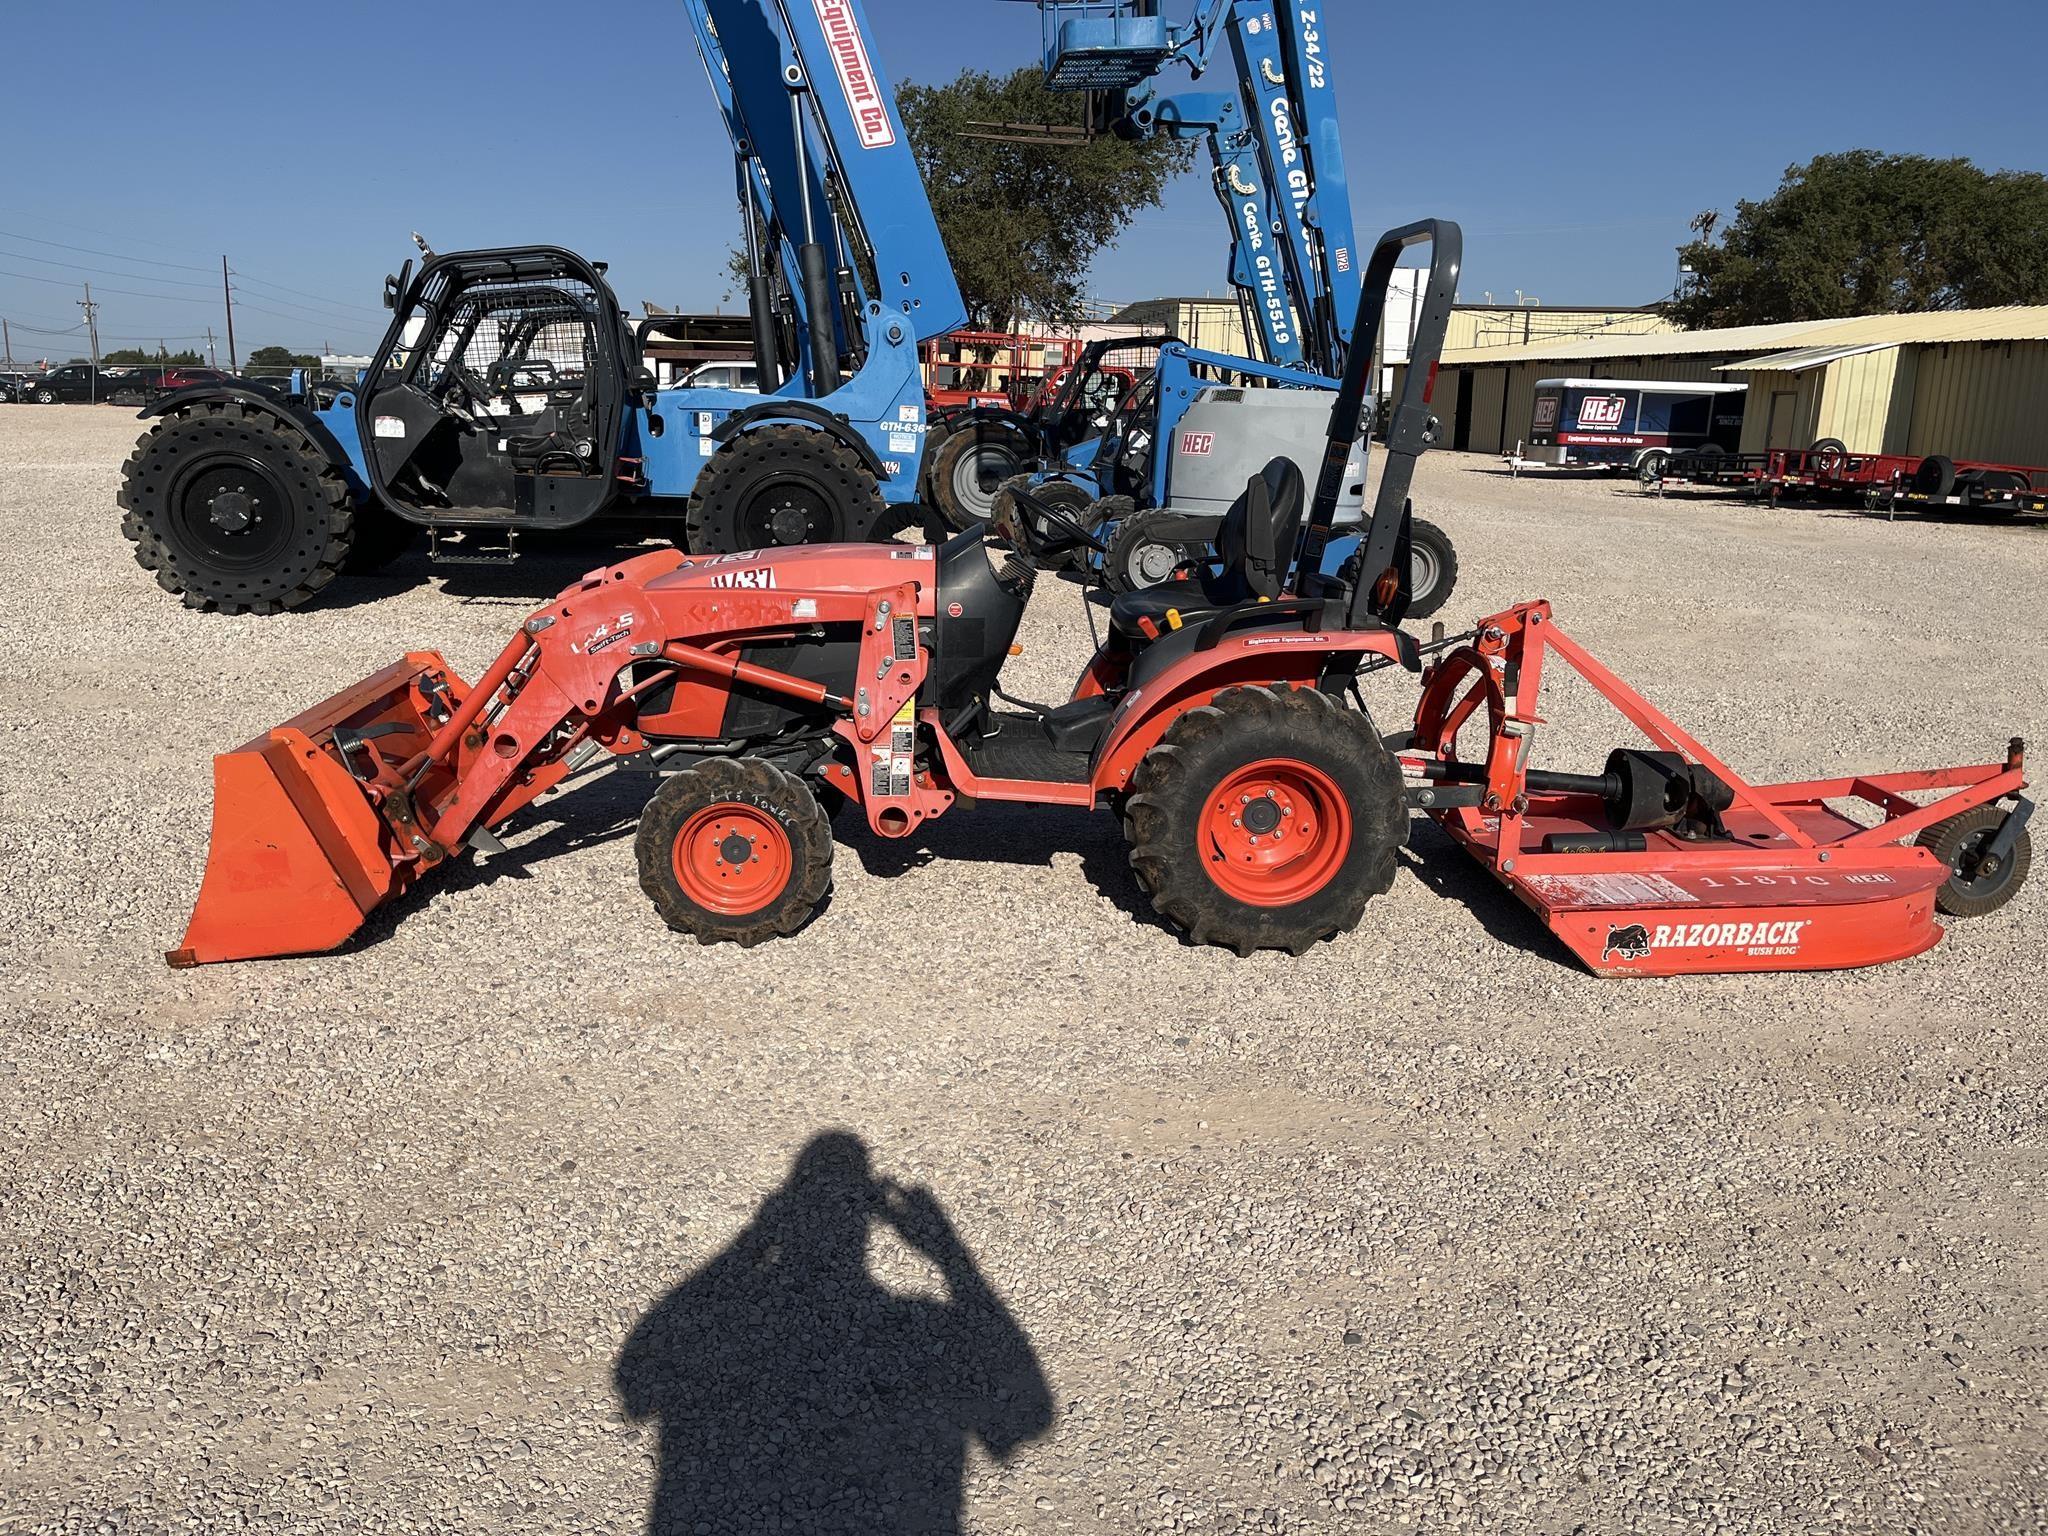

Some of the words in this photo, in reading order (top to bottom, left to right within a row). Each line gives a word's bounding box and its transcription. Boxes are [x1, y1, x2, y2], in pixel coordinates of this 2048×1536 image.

[1301, 10, 1325, 88] Z-34/22
[822, 0, 874, 103] Equipment
[860, 107, 882, 140] Co.
[1271, 97, 1297, 168] Genie
[1243, 202, 1263, 252] Genie
[1255, 256, 1290, 344] GTH-5519
[1582, 401, 1622, 421] HEC
[880, 421, 926, 433] GTH-636
[1182, 434, 1213, 453] HEC
[881, 462, 899, 475] 42
[591, 629, 629, 653] Swift-Tach
[1848, 873, 1891, 883] HEC
[1651, 921, 1804, 948] RAZORBACK
[1747, 947, 1773, 956] BUSH
[1774, 946, 1797, 955] HOG
